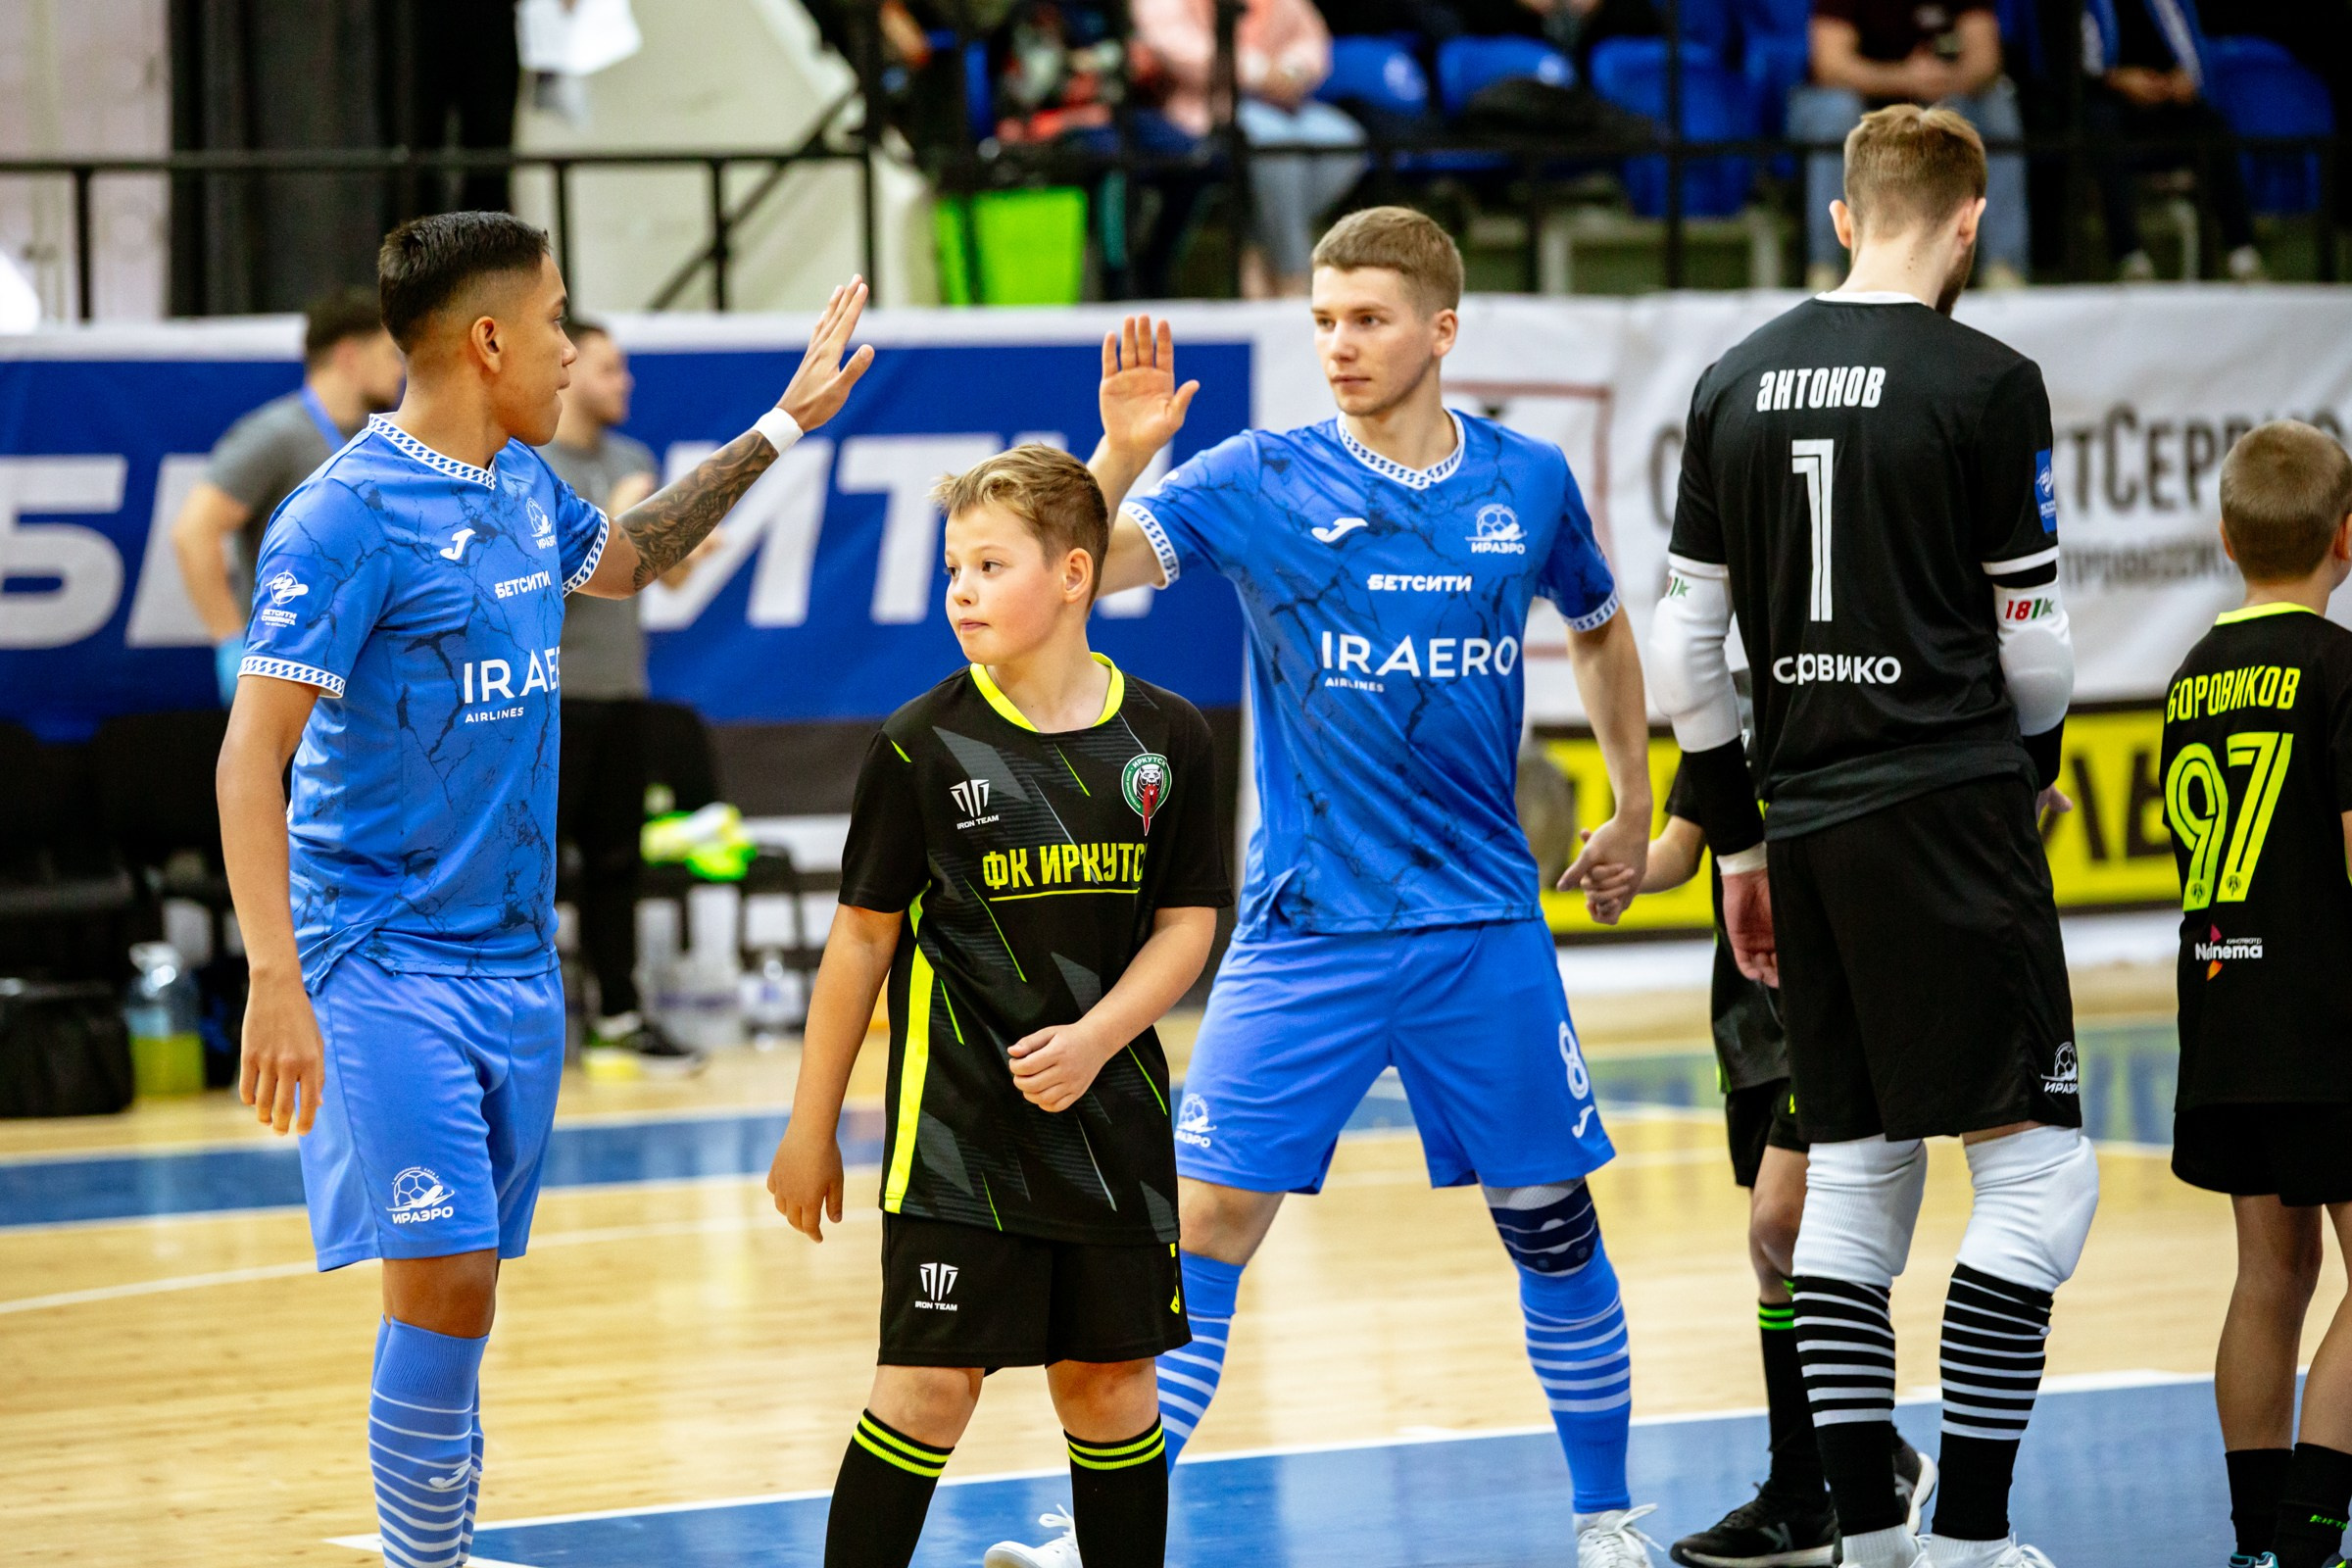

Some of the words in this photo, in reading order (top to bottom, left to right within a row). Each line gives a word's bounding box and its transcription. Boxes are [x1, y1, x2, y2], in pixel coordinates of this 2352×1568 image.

[1791, 438, 1835, 621] 1
[1470, 541, 1526, 556] ИРАЭРО
[494, 569, 551, 600] БЕТСИТИ
[1367, 573, 1473, 592] БЕТСИТИ
[1322, 630, 1519, 678] IRAERO
[1772, 652, 1901, 686] СРВИКО
[1324, 676, 1385, 693] AIRLINES
[2166, 664, 2301, 724] БОРОВИКОВ
[465, 706, 524, 723] AIRLINES
[956, 819, 976, 830] IRON
[975, 814, 1000, 825] TEAM
[2165, 731, 2294, 911] 97
[982, 848, 1035, 890] ФК
[1039, 842, 1148, 885] ИРКУТС
[1558, 1020, 1590, 1101] 8
[392, 1205, 455, 1225] ИРАЭРО
[914, 1300, 934, 1310] IRON
[934, 1302, 958, 1311] TEAM
